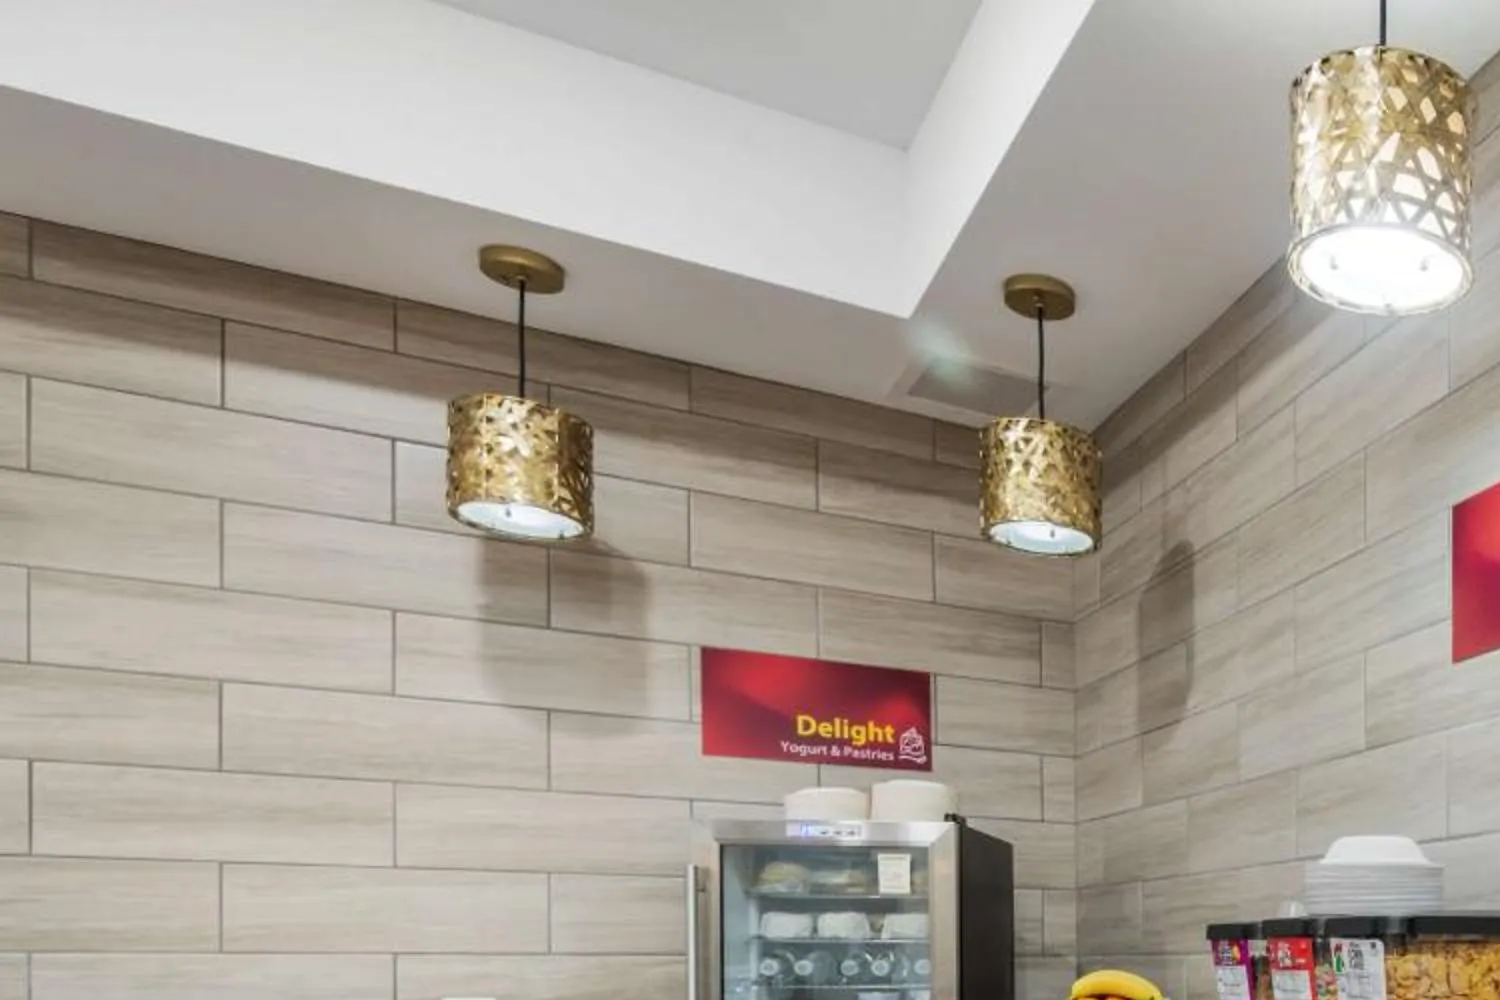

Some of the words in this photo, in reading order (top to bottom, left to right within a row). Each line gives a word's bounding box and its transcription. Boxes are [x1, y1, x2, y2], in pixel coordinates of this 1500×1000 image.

[796, 715, 896, 746] Delight
[780, 740, 828, 757] Yogurt
[831, 744, 841, 757] &
[844, 746, 895, 762] Pastries
